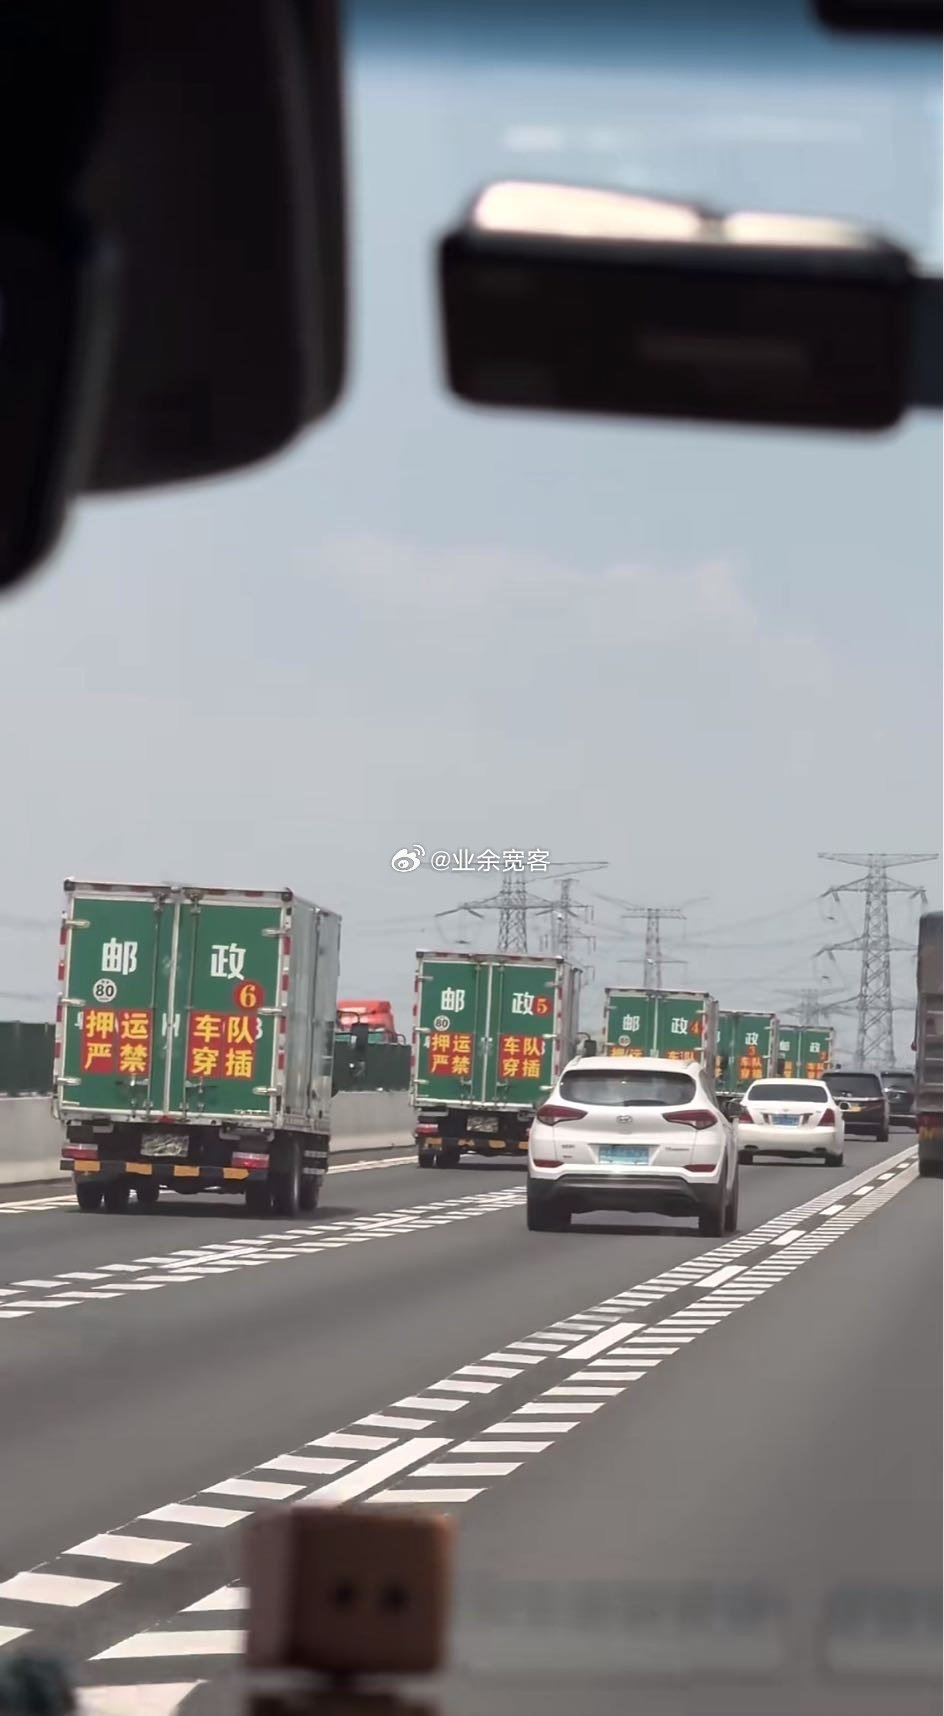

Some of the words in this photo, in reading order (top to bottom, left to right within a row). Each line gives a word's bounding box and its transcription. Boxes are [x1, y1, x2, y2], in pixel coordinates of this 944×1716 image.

[95, 984, 114, 997] 80
[240, 984, 257, 1008] 6
[537, 998, 548, 1014] 5
[690, 1021, 701, 1034] 4
[745, 1032, 758, 1045] 政
